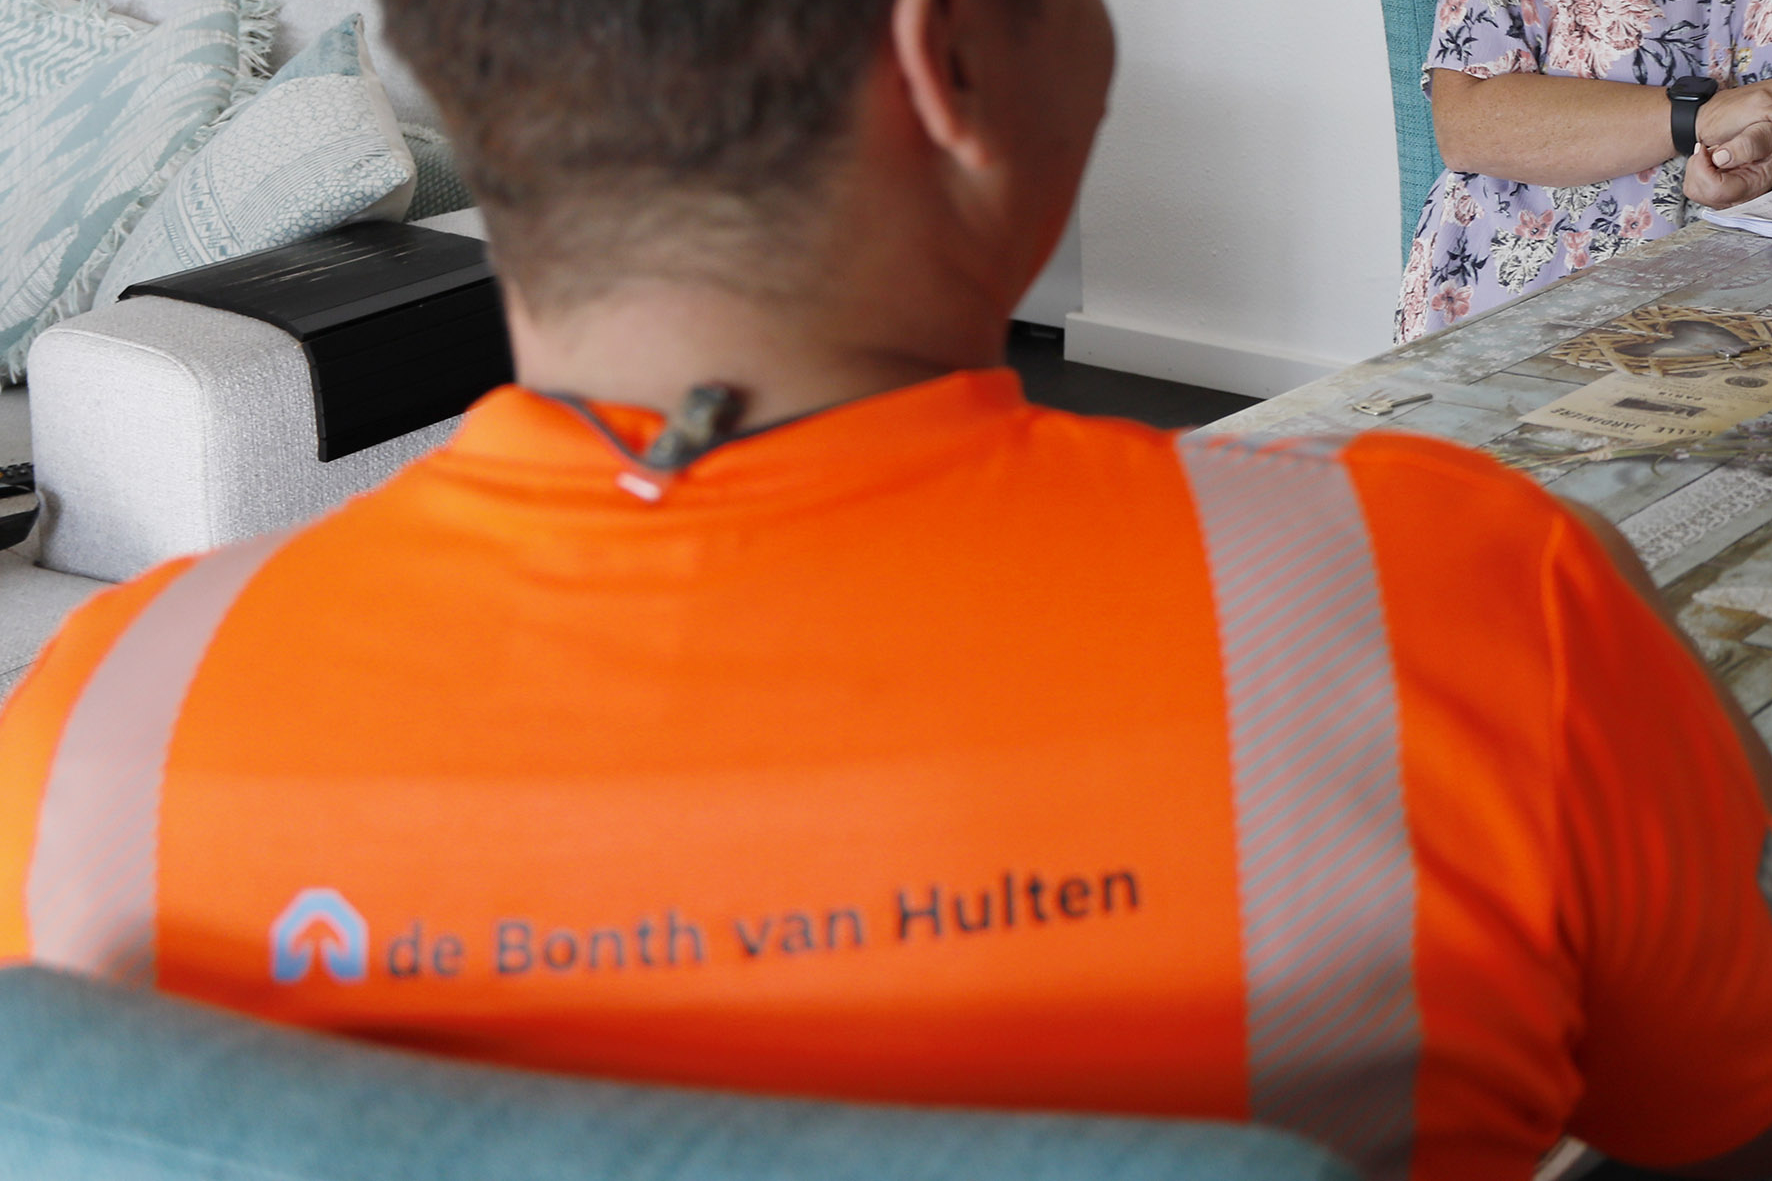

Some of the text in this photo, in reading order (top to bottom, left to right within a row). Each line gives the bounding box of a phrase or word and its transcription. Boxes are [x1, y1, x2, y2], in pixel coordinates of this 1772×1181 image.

[386, 866, 1142, 980] de Bonth van Hulten
